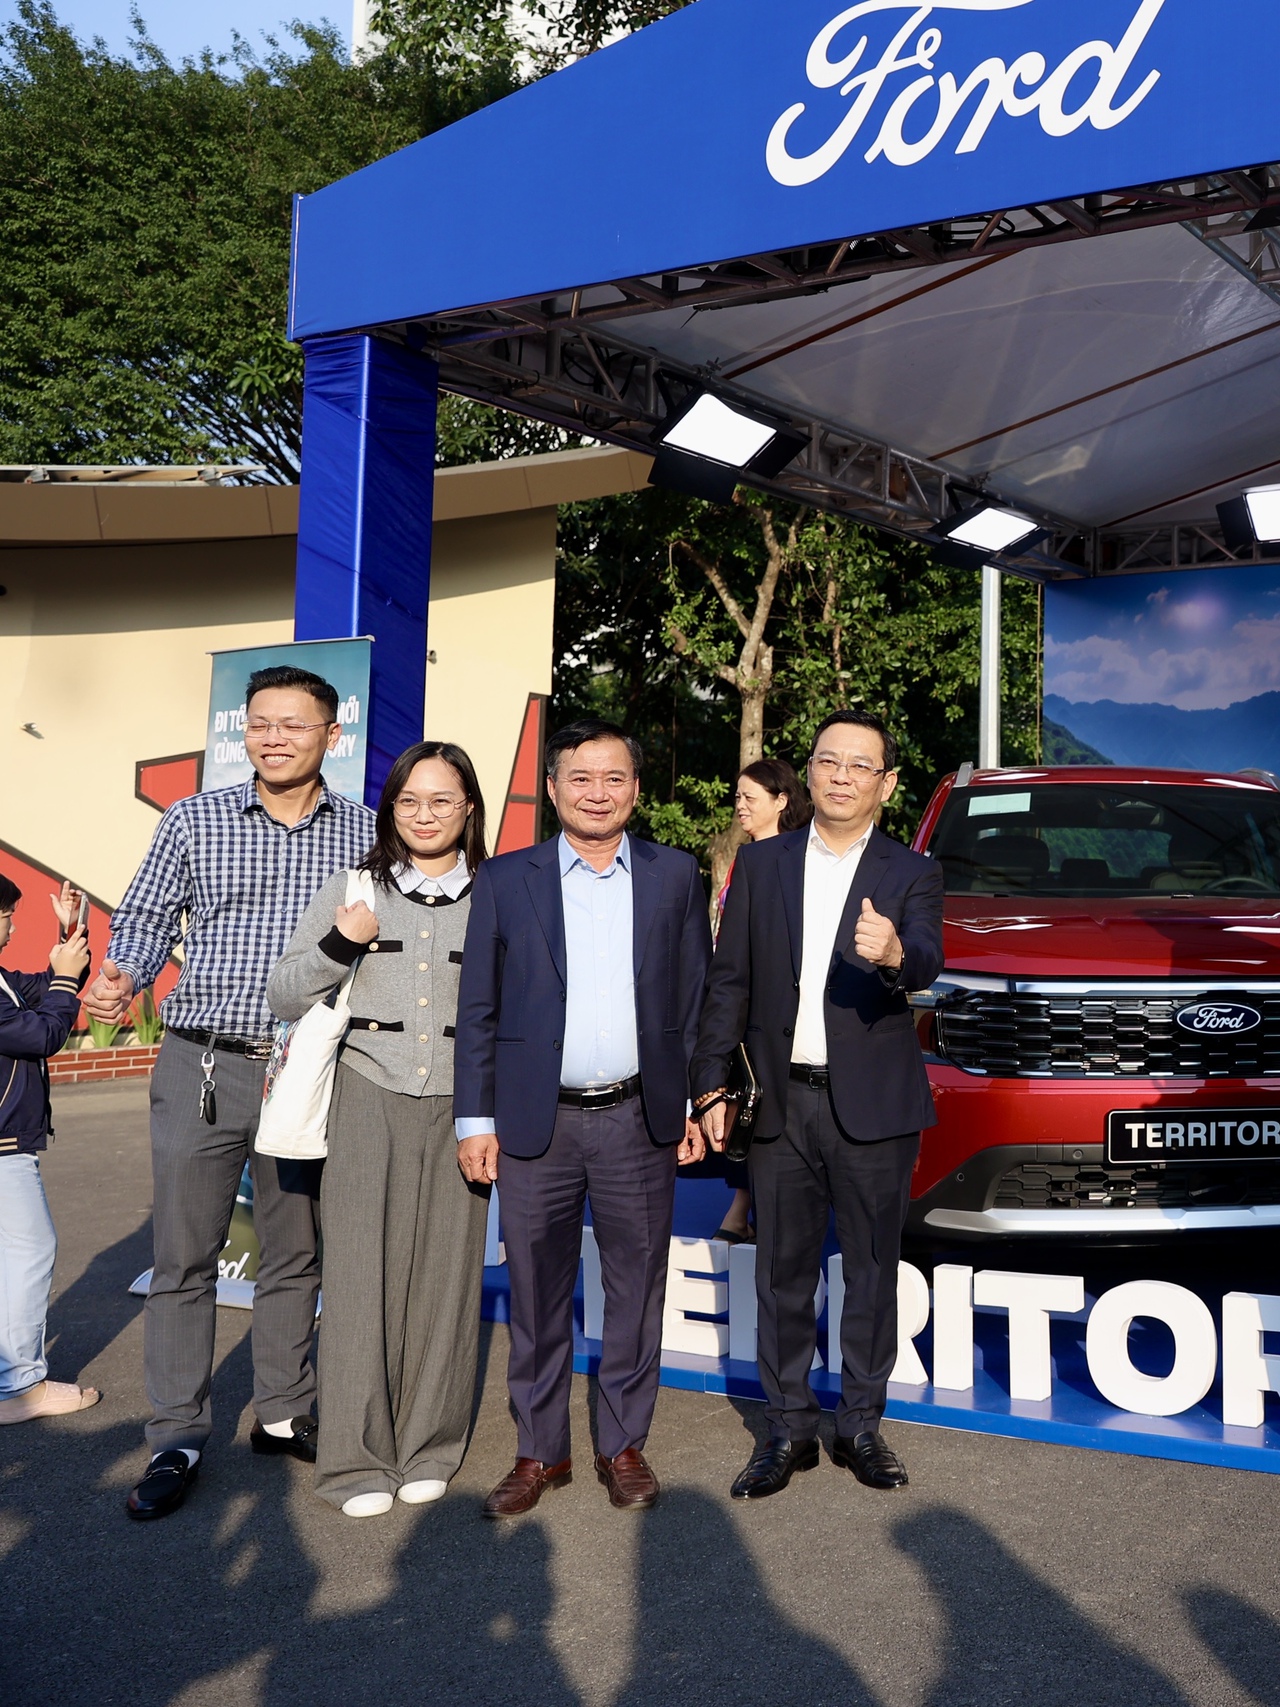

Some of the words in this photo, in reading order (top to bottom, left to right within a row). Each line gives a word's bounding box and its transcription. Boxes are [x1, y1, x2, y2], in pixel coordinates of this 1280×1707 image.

[765, 0, 1165, 187] Ford
[214, 710, 229, 733] ĐI
[214, 736, 246, 764] CÙNG
[1193, 1006, 1245, 1029] Ford
